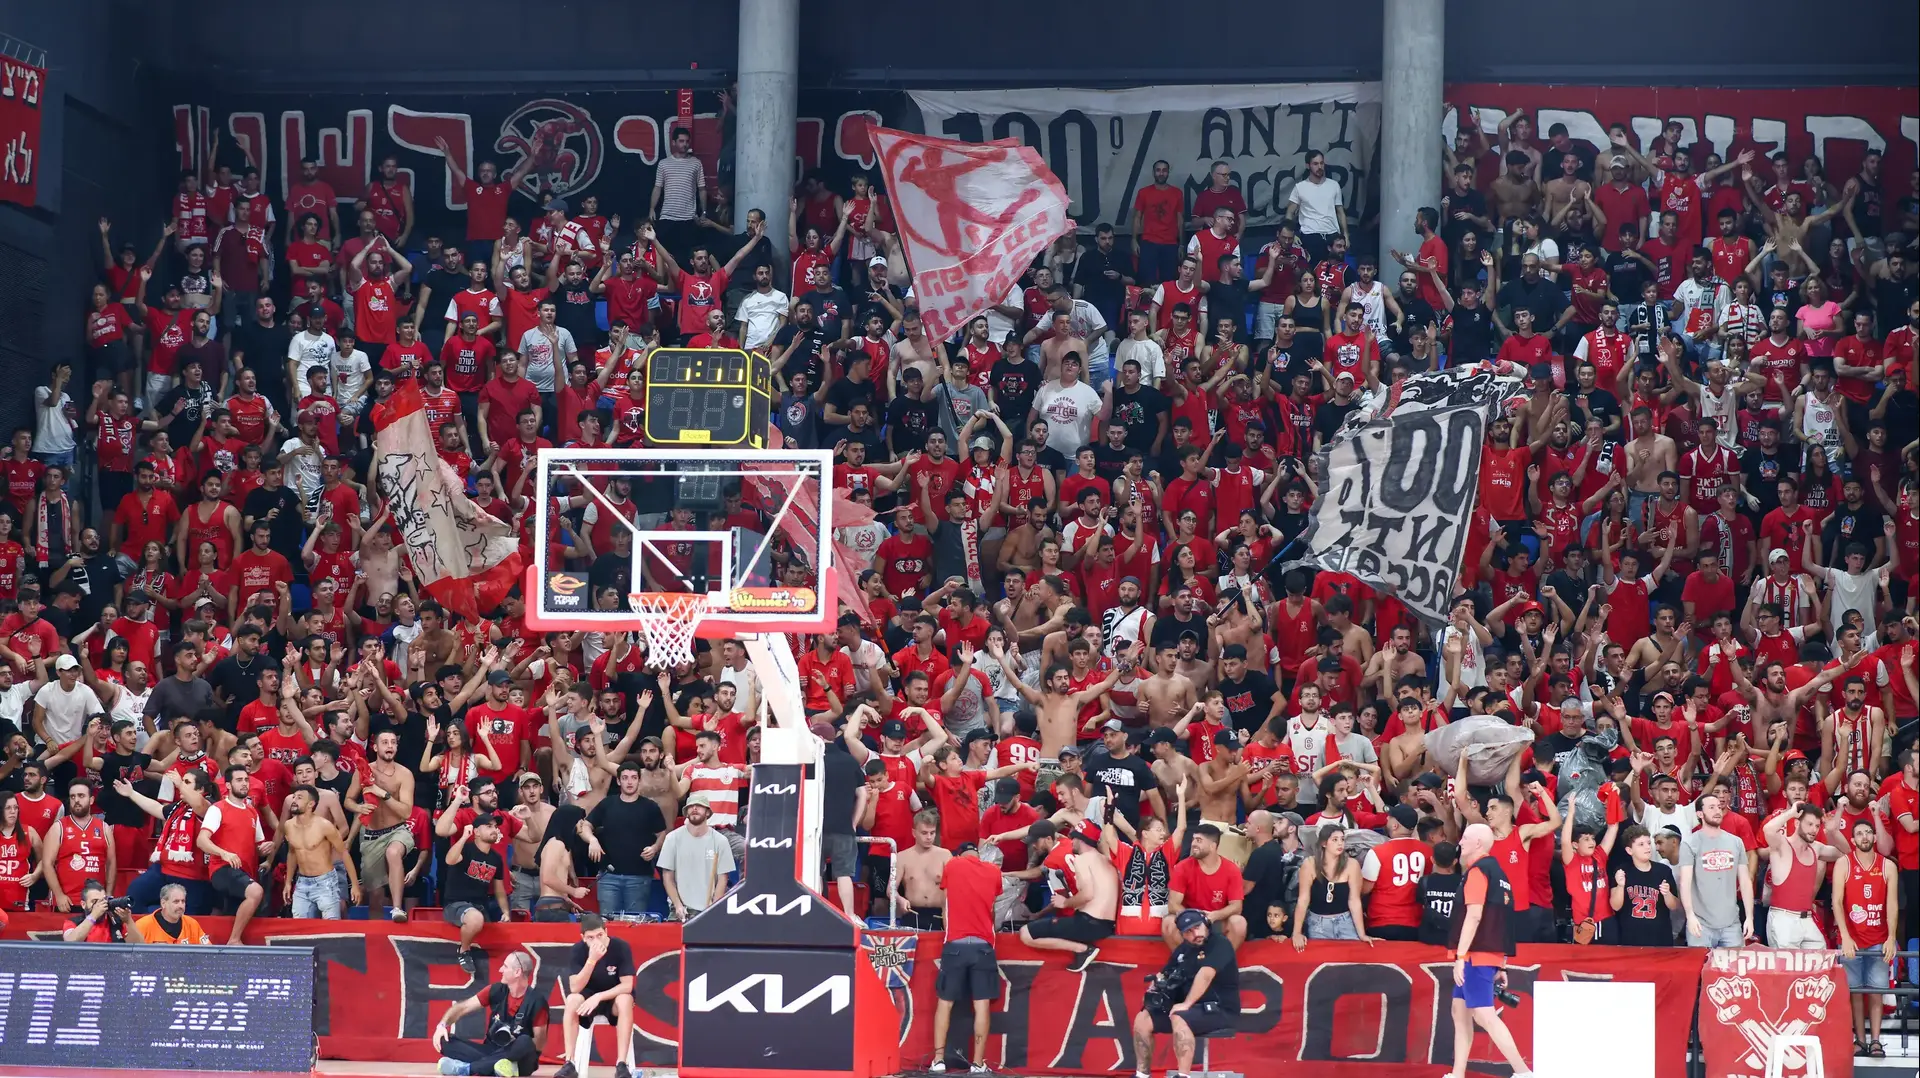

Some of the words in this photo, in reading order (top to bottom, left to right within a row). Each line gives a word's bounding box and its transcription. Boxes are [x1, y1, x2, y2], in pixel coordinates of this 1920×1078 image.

[1197, 100, 1359, 161] ANTI
[1319, 271, 1335, 284] 52
[738, 593, 791, 607] Winner
[1009, 743, 1041, 766] 99
[1096, 770, 1121, 781] NORTH
[1101, 777, 1121, 786] FACE
[755, 783, 797, 795] KIA
[80, 841, 90, 855] 5
[750, 836, 793, 849] KIA
[1, 844, 18, 858] 14
[1391, 850, 1426, 887] 99
[1863, 884, 1873, 899] 5
[727, 893, 812, 917] KIA
[1631, 898, 1658, 919] 23
[688, 972, 851, 1015] KIA
[168, 1000, 247, 1031] 2023
